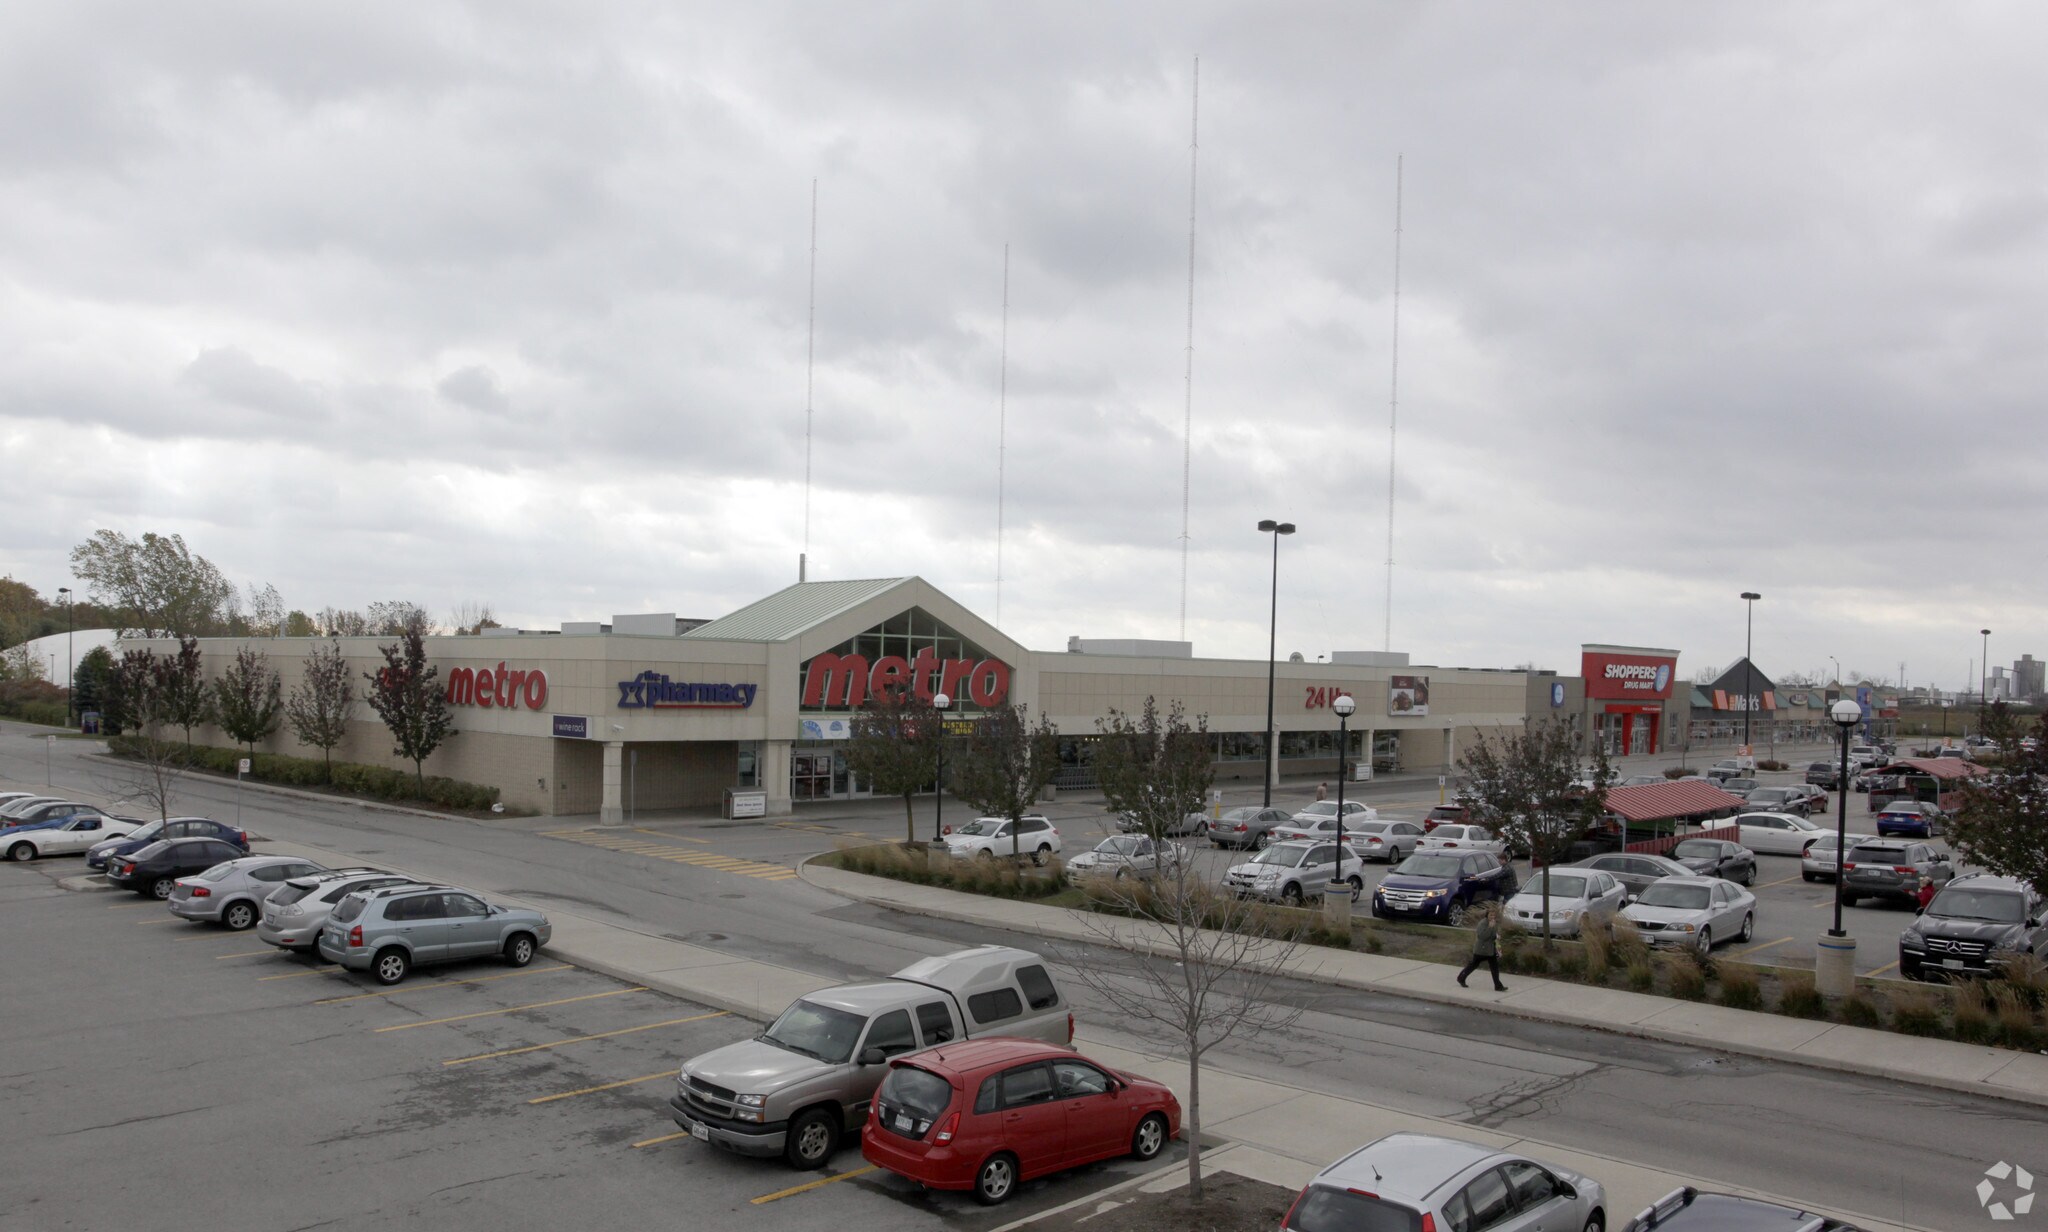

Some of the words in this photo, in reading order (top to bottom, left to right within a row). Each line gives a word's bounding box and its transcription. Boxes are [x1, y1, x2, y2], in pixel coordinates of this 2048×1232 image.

[644, 670, 661, 681] the
[801, 646, 1009, 707] metro
[1604, 664, 1658, 679] SHOPPERS
[447, 660, 548, 710] metro
[646, 674, 757, 708] pharmacy
[1624, 681, 1639, 689] DRUG
[1639, 681, 1654, 689] MART
[1305, 686, 1326, 709] 24
[1735, 694, 1760, 711] Mak's
[559, 721, 572, 731] wine
[572, 722, 585, 732] rack
